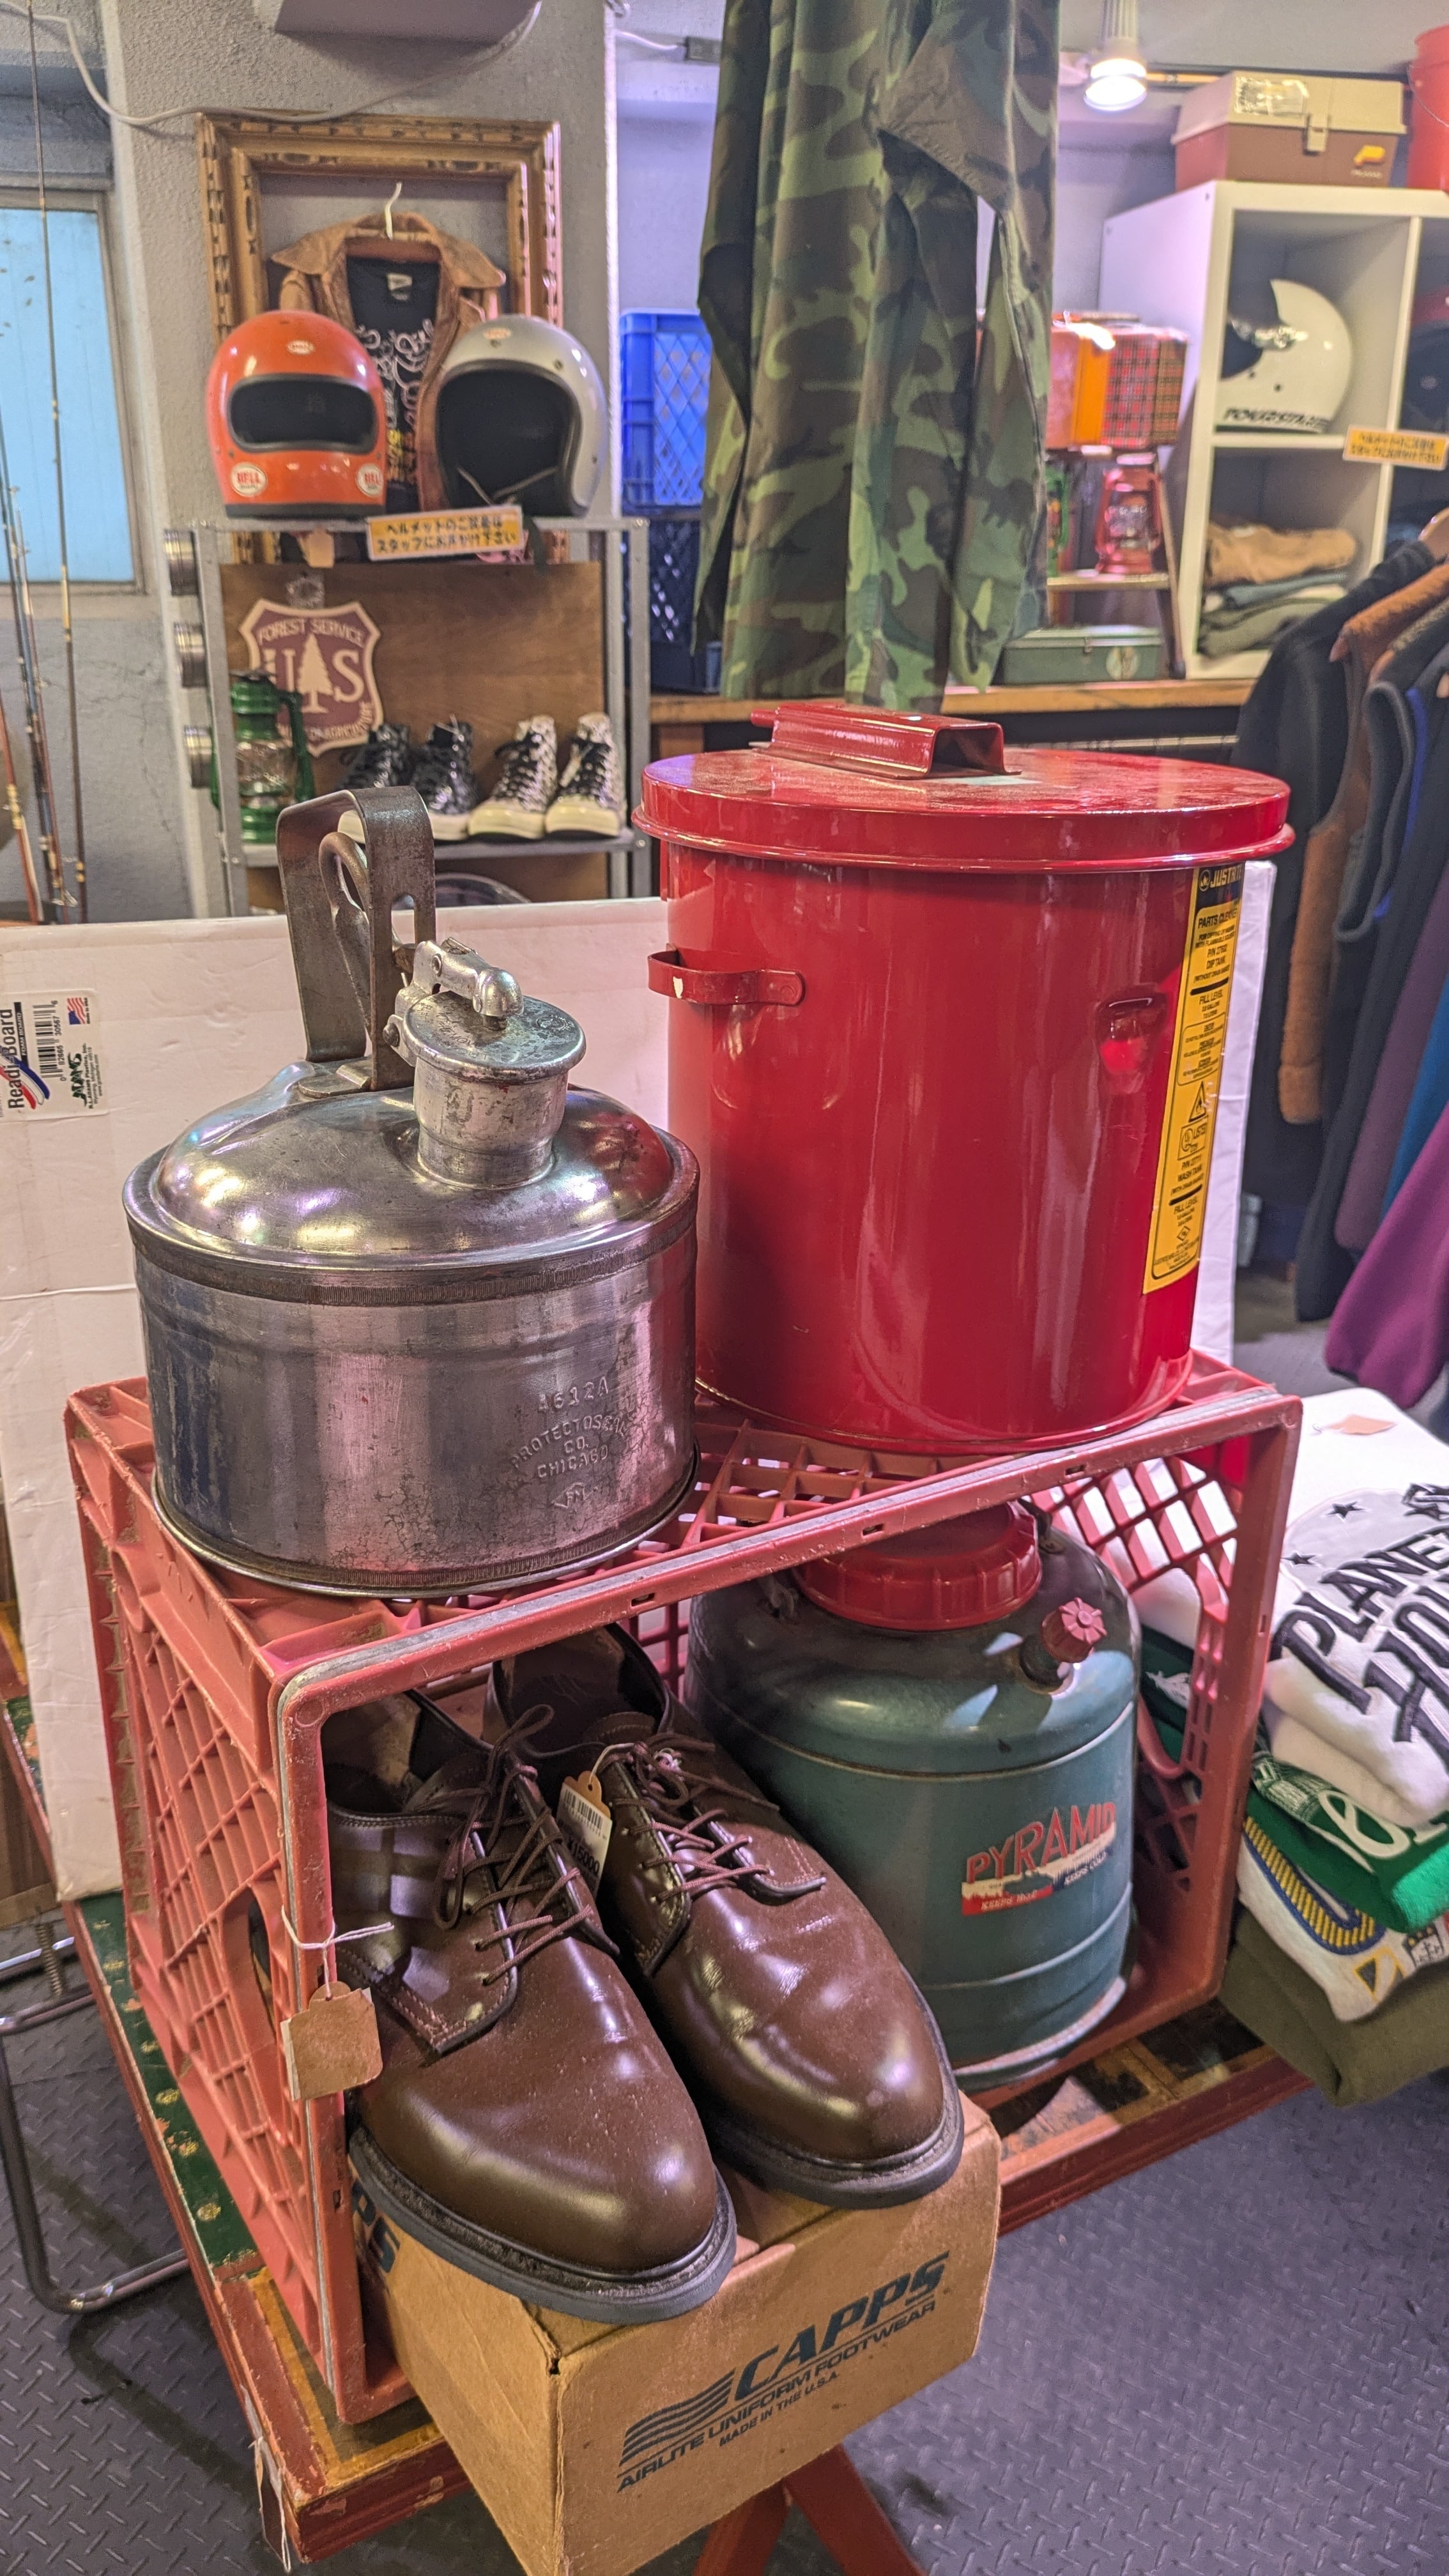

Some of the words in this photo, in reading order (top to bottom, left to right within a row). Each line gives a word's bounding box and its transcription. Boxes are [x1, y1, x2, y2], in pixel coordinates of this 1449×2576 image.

[259, 618, 306, 645] FOREST
[310, 618, 364, 648] SERVICE
[334, 649, 365, 702] S
[1198, 914, 1218, 929] PARTS
[0, 1009, 25, 1109] Readi-Board
[510, 1413, 626, 1469] PROTECTOSEAL
[537, 1444, 608, 1478] CHICAGO
[564, 1436, 588, 1453] CO.
[967, 1802, 1116, 1885] PYRAMID
[735, 2250, 949, 2401] CAPPS
[617, 2432, 705, 2492] AIRLITE
[708, 2369, 813, 2439] UNIFORM
[815, 2299, 935, 2377] FOOTWEAR
[719, 2418, 758, 2446] MADE
[759, 2405, 774, 2423] IN
[778, 2389, 801, 2411] THE
